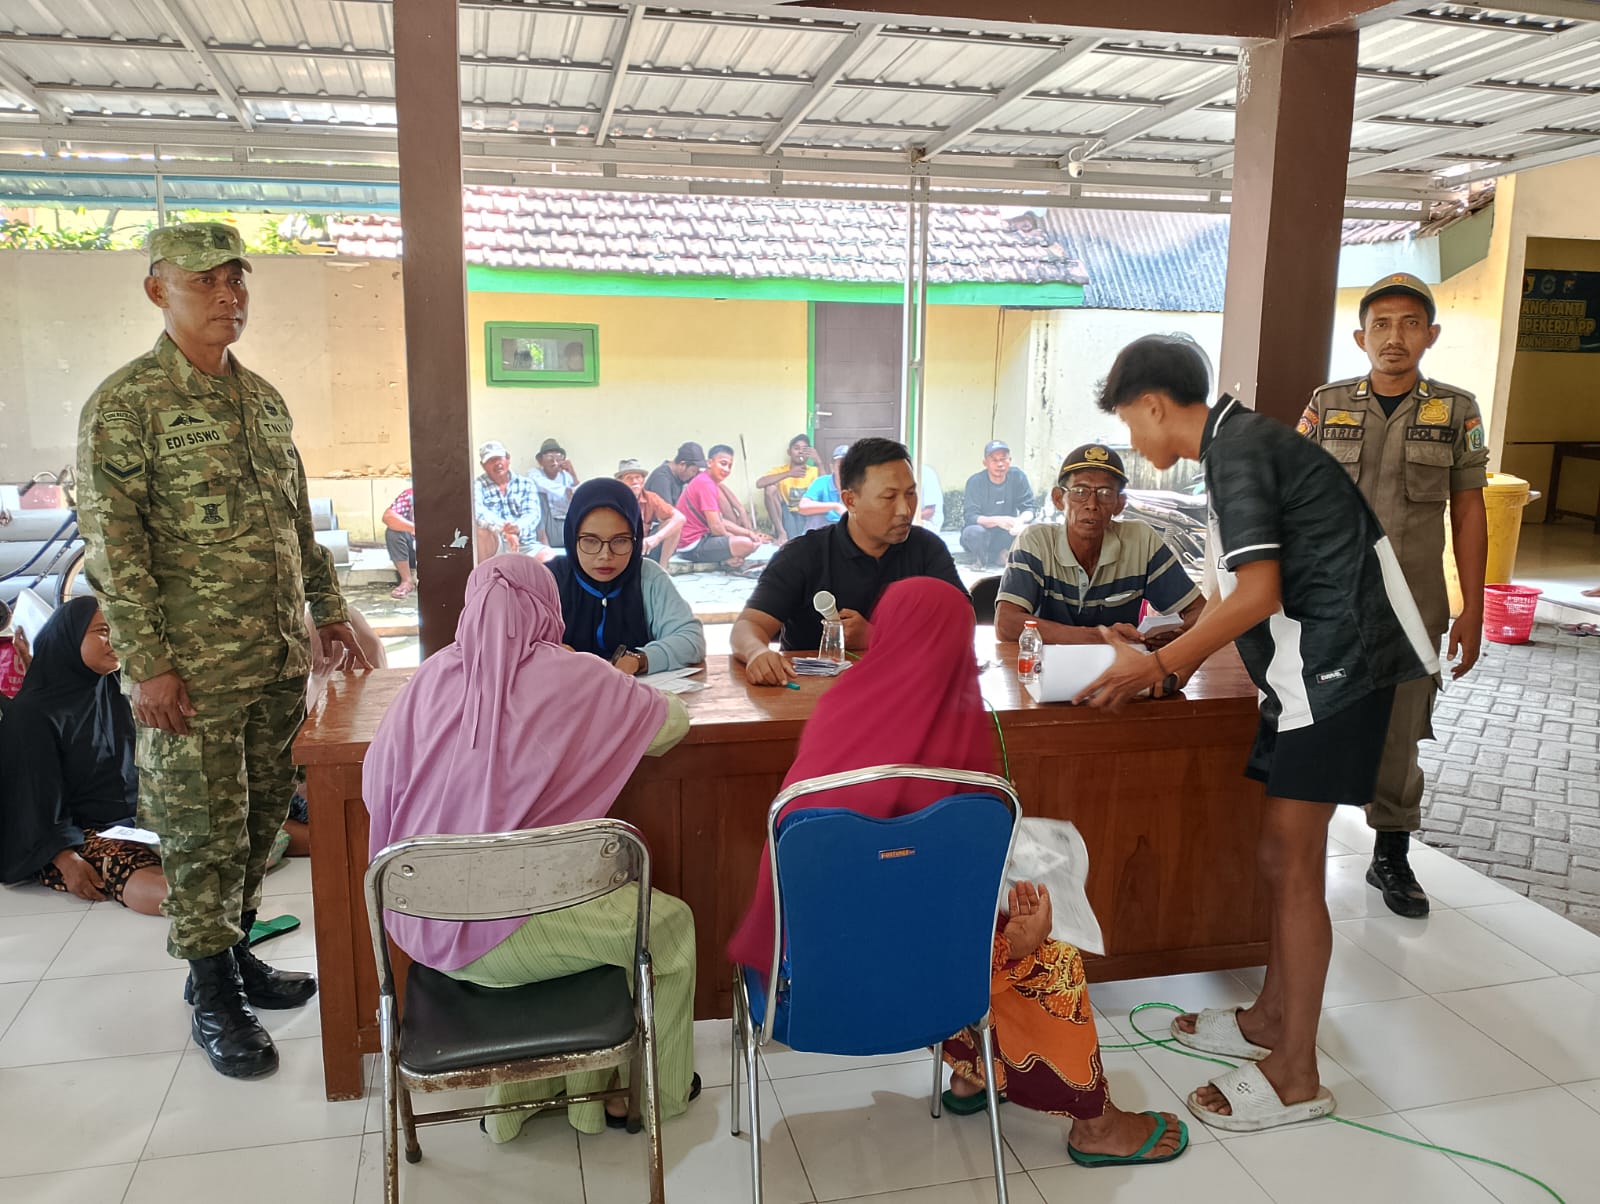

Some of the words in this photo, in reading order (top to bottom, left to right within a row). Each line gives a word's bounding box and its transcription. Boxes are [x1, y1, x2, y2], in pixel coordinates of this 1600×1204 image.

[1550, 301, 1585, 317] GANTI
[1525, 318, 1575, 334] PEKERJA
[264, 423, 284, 434] TNI
[1325, 428, 1359, 439] FARIS
[1410, 429, 1432, 440] POL
[166, 436, 186, 450] EDI
[187, 430, 221, 445] SISWO
